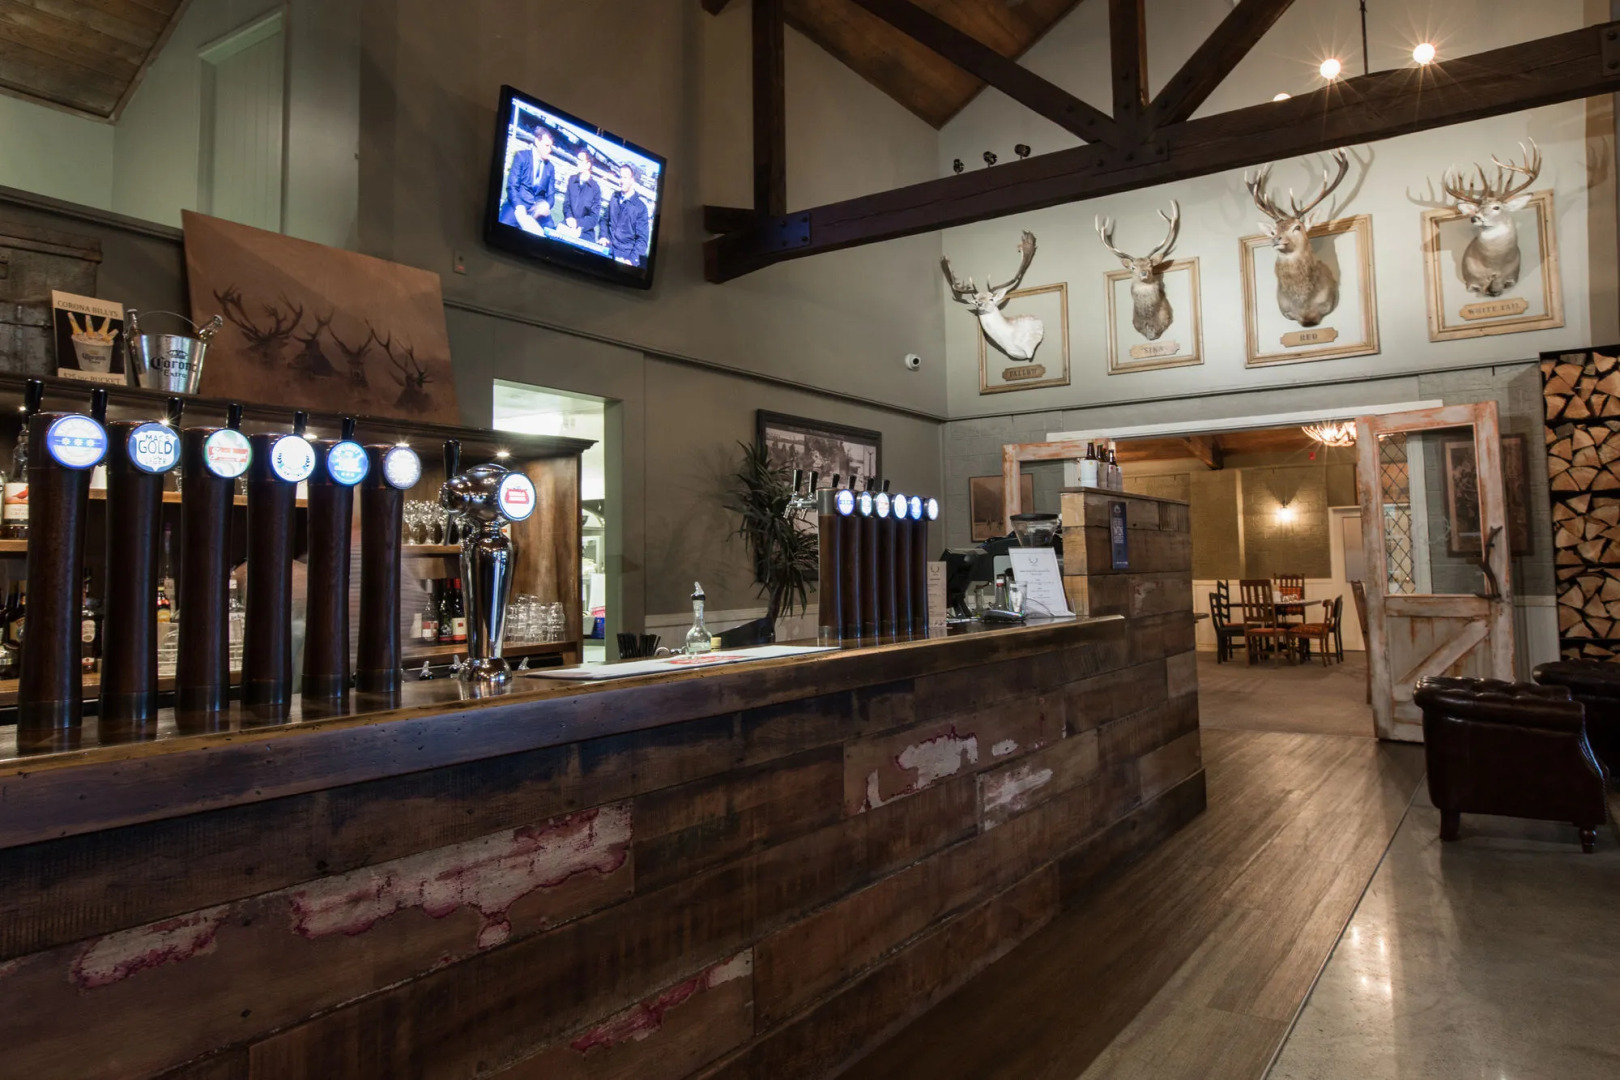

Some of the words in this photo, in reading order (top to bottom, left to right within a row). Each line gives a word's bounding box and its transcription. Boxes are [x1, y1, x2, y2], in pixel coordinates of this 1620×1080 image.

[57, 300, 91, 313] CORONA
[91, 306, 119, 318] BILLYS
[1468, 304, 1497, 314] WHITE
[1500, 302, 1519, 311] TAIL
[1299, 333, 1318, 342] RED
[150, 356, 197, 372] Corona
[163, 369, 188, 379] Extra
[1009, 368, 1037, 378] FALLOW
[138, 440, 173, 455] GOLD
